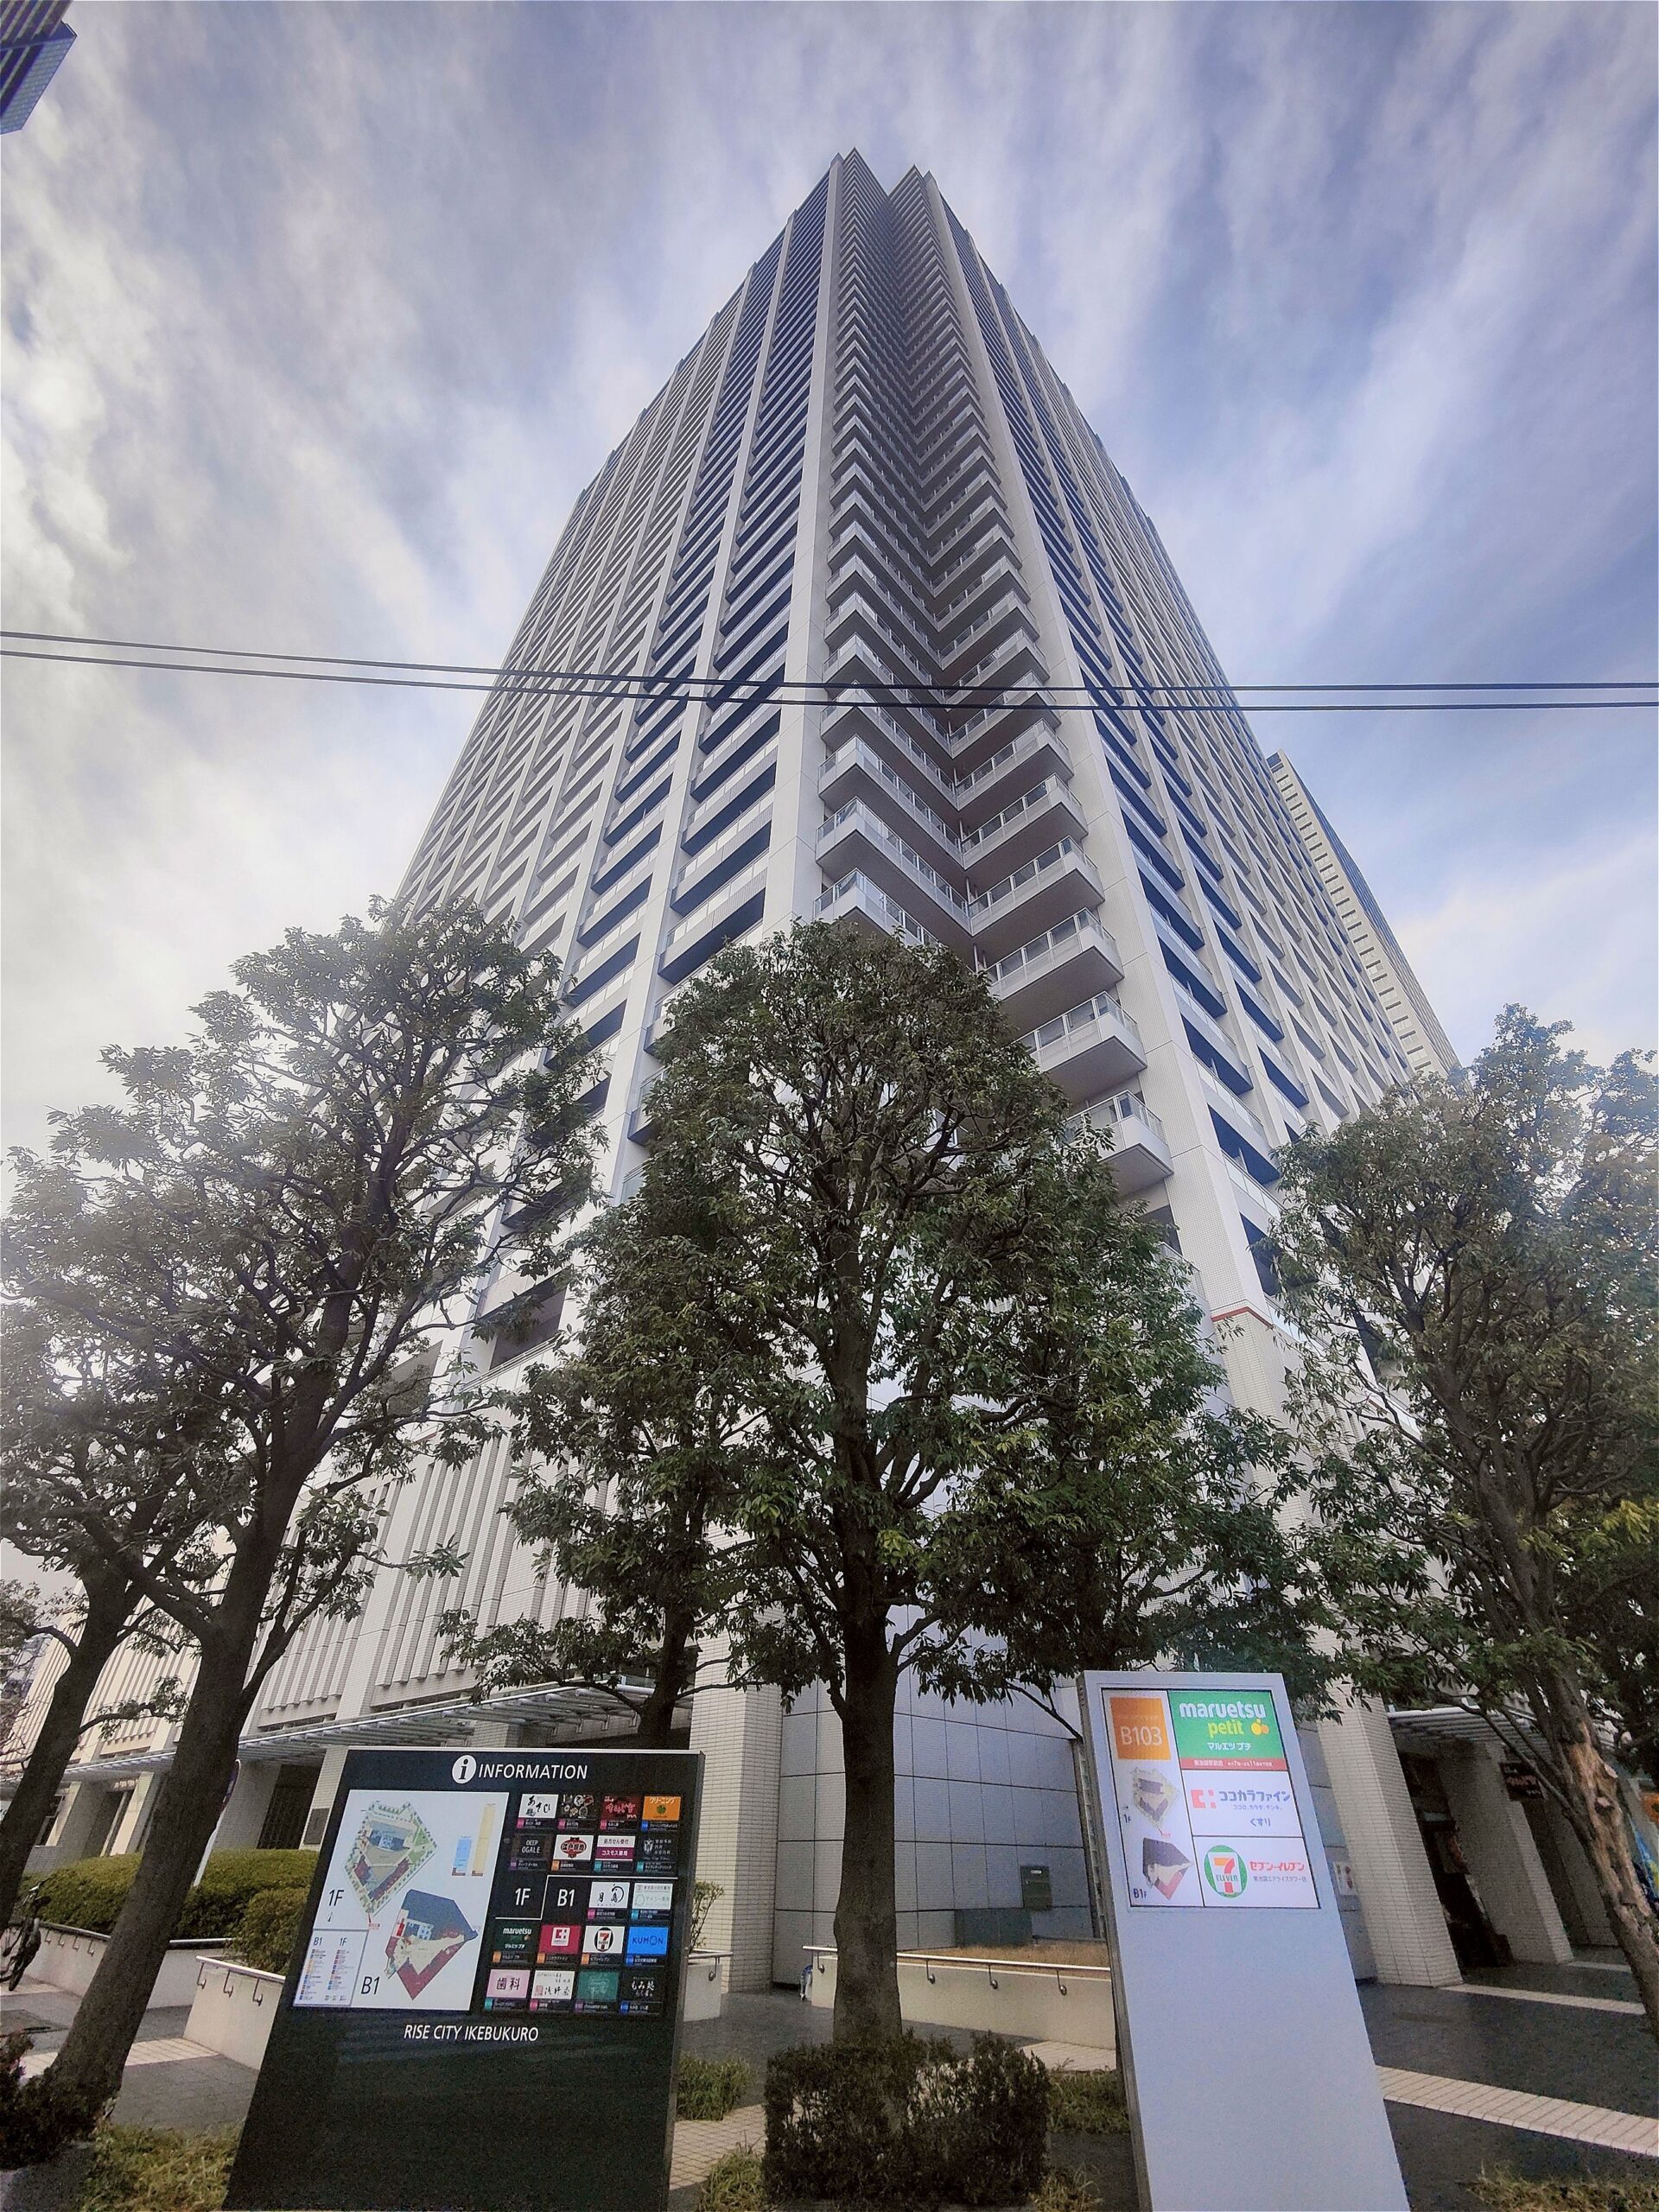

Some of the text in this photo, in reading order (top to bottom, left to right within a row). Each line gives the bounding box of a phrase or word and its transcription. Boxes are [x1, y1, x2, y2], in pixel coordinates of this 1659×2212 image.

[1179, 1700, 1267, 1718] maruetsu
[1120, 1726, 1163, 1746] B103
[1208, 1719, 1244, 1738] petit
[479, 1764, 588, 1780] INFORMATION
[1218, 1789, 1291, 1802] ココカラファイン
[1249, 1817, 1271, 1827] くすり
[329, 1890, 345, 1907] 1F
[516, 1888, 531, 1906] 1F
[557, 1889, 575, 1907] B1
[314, 1936, 323, 1946] B1
[340, 1937, 347, 1946] 1F
[632, 1936, 664, 1946] KUMON
[361, 1976, 380, 1995] B1
[496, 1977, 521, 1991] 歯科
[404, 2024, 539, 2042] RISE CITY IKEBUKURO
